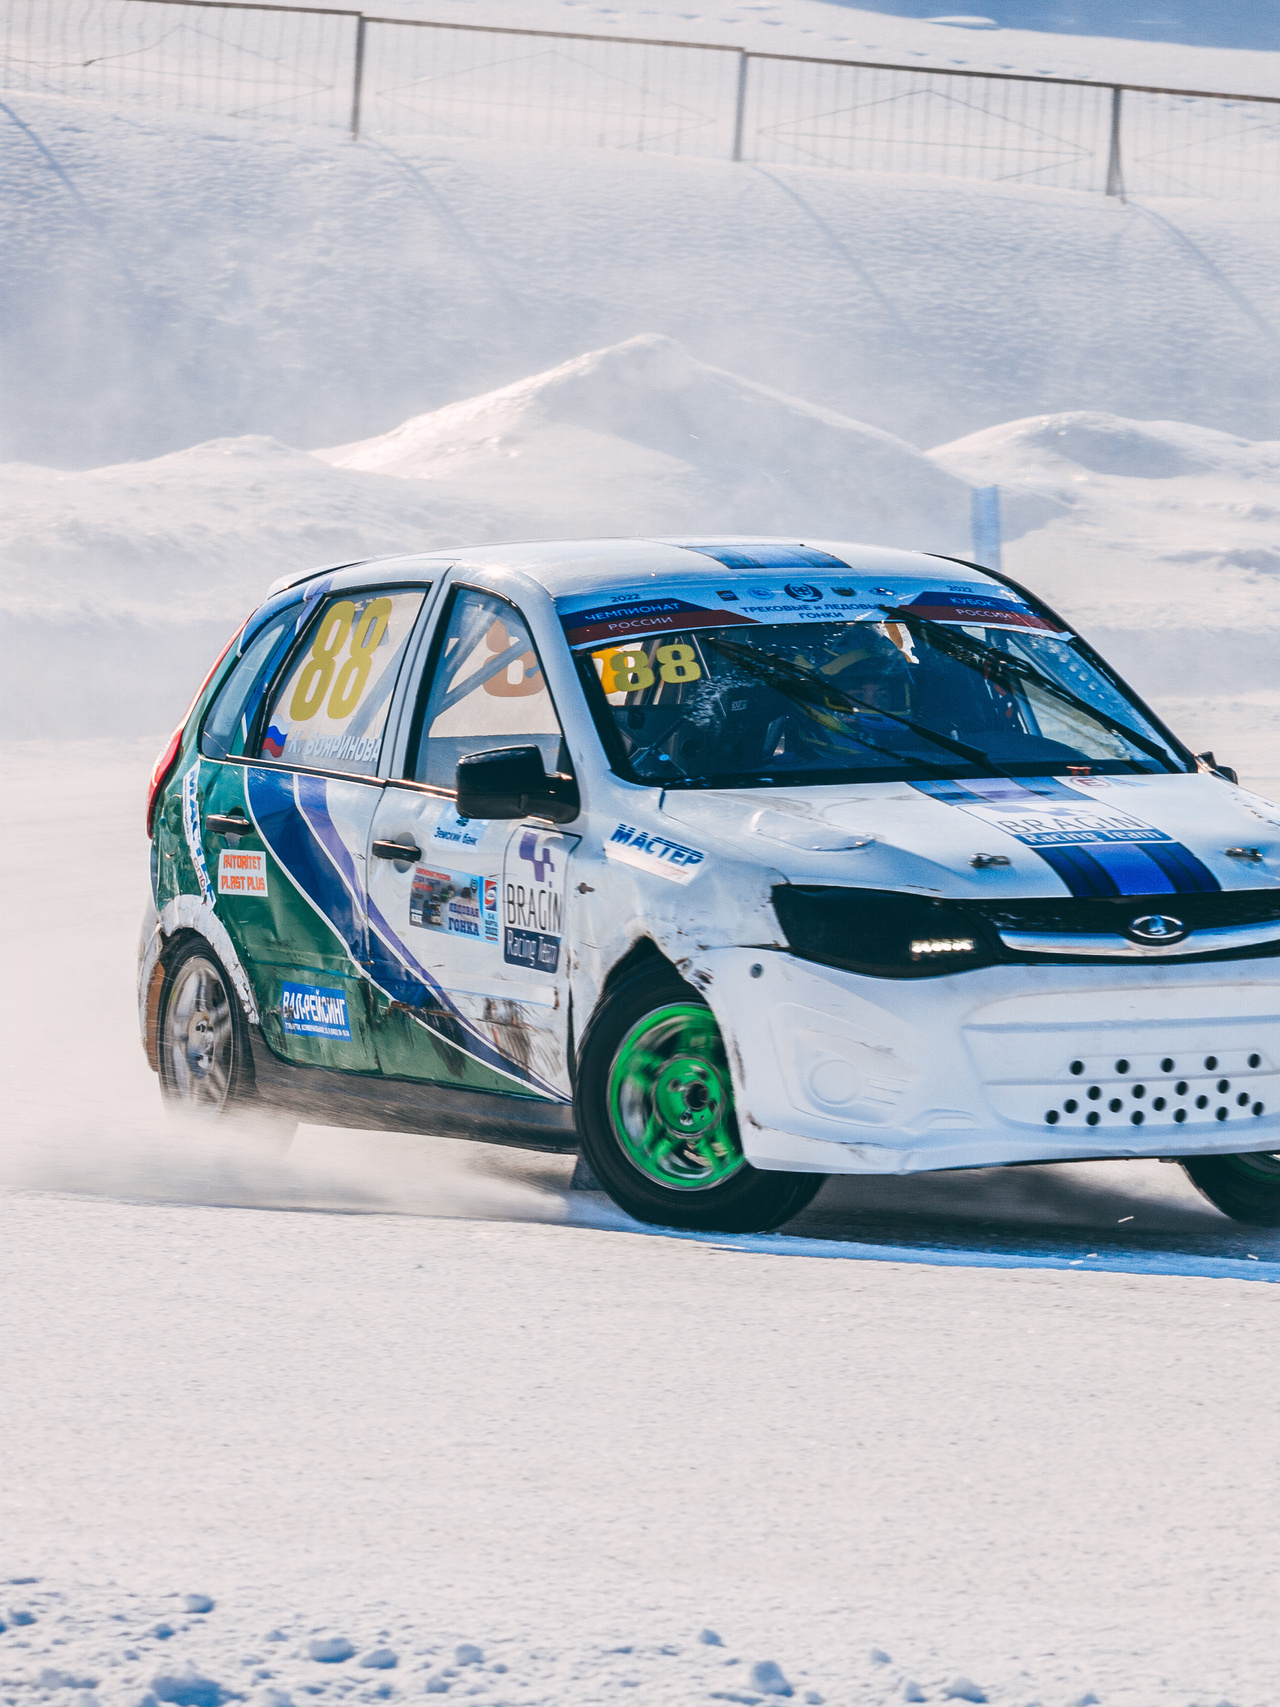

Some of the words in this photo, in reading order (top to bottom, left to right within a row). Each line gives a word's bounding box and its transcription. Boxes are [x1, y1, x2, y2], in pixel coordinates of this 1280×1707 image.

[611, 593, 641, 603] 2022
[949, 597, 997, 607] КУБОК
[585, 602, 680, 621] ЧЕМПИОНАТ
[740, 604, 813, 613] ТРЕКОВЫЕ
[824, 603, 884, 611] ЛЕДОВЫ
[798, 611, 844, 619] ГОНКИ
[955, 608, 1013, 620] РОССИИ
[608, 616, 673, 631] РОССИИ
[290, 598, 393, 721] 88
[610, 644, 702, 692] 88
[304, 731, 382, 763] БОЯРИНОВА
[997, 816, 1145, 833] BRAGIN
[434, 826, 461, 842] Земский
[1020, 831, 1104, 844] Racing
[1103, 828, 1164, 842] Team
[610, 823, 705, 867] МАСТЕР
[221, 875, 245, 891] PLAST
[247, 876, 266, 891] PLUS
[507, 883, 562, 934] BRAGIN
[448, 917, 480, 937] ГОНКА
[507, 930, 537, 966] Racing
[538, 936, 558, 965] Team
[282, 989, 346, 1026] ВАЛ-РЕЙСИНГ
